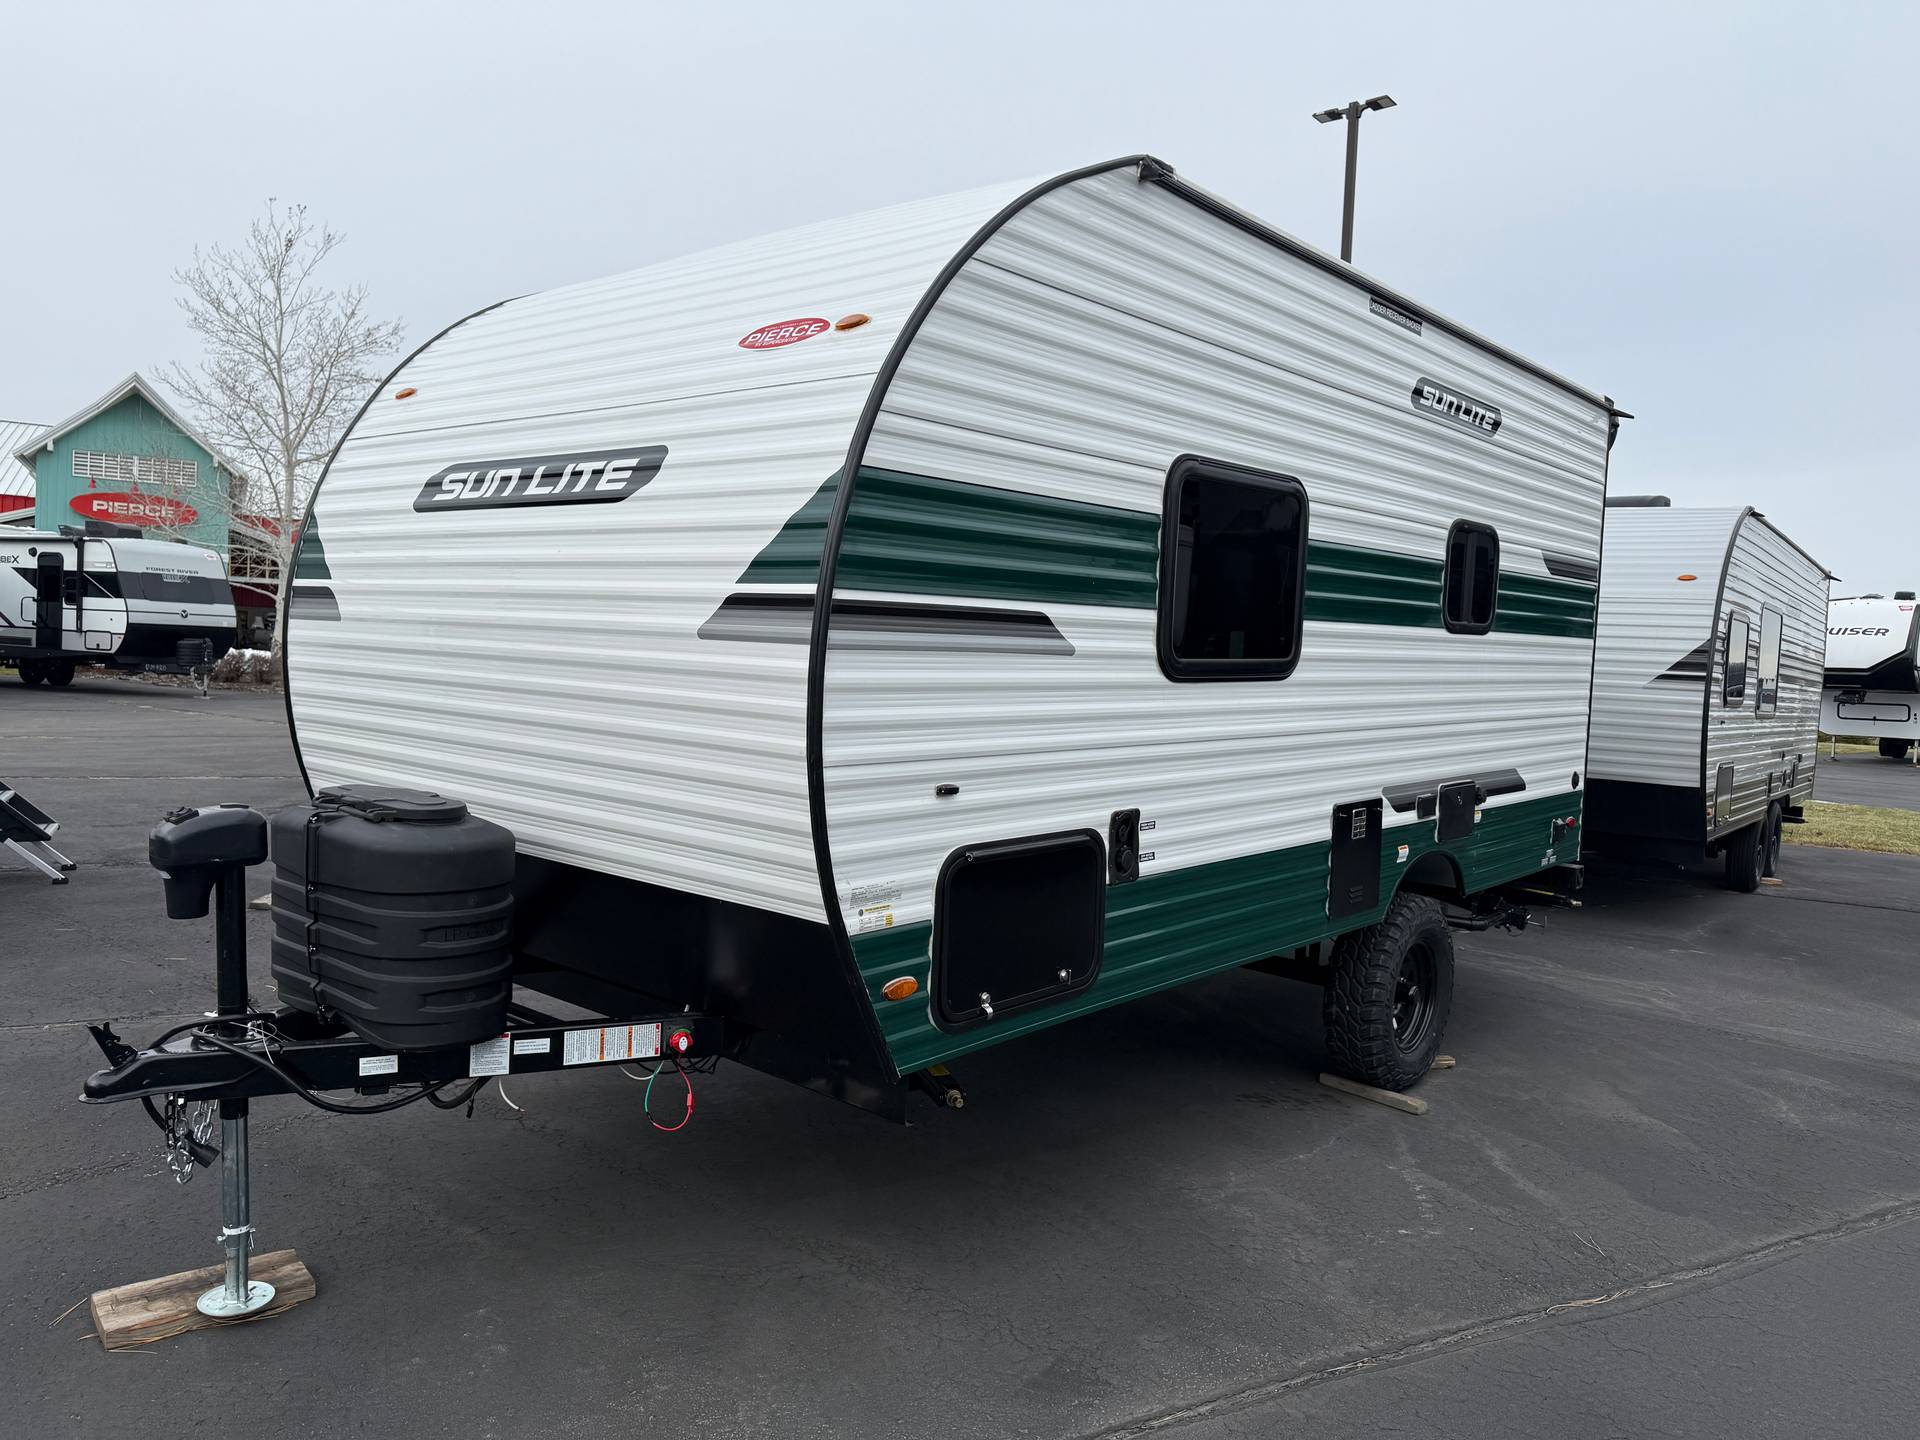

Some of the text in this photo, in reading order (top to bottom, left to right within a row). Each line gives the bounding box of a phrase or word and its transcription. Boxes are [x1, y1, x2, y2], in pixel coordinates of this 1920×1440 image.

[744, 322, 824, 345] PIERCE
[1419, 385, 1496, 431] SUN LITE
[431, 458, 641, 501] SUN LITE
[92, 499, 175, 518] PIERCE
[1826, 627, 1890, 637] UISER
